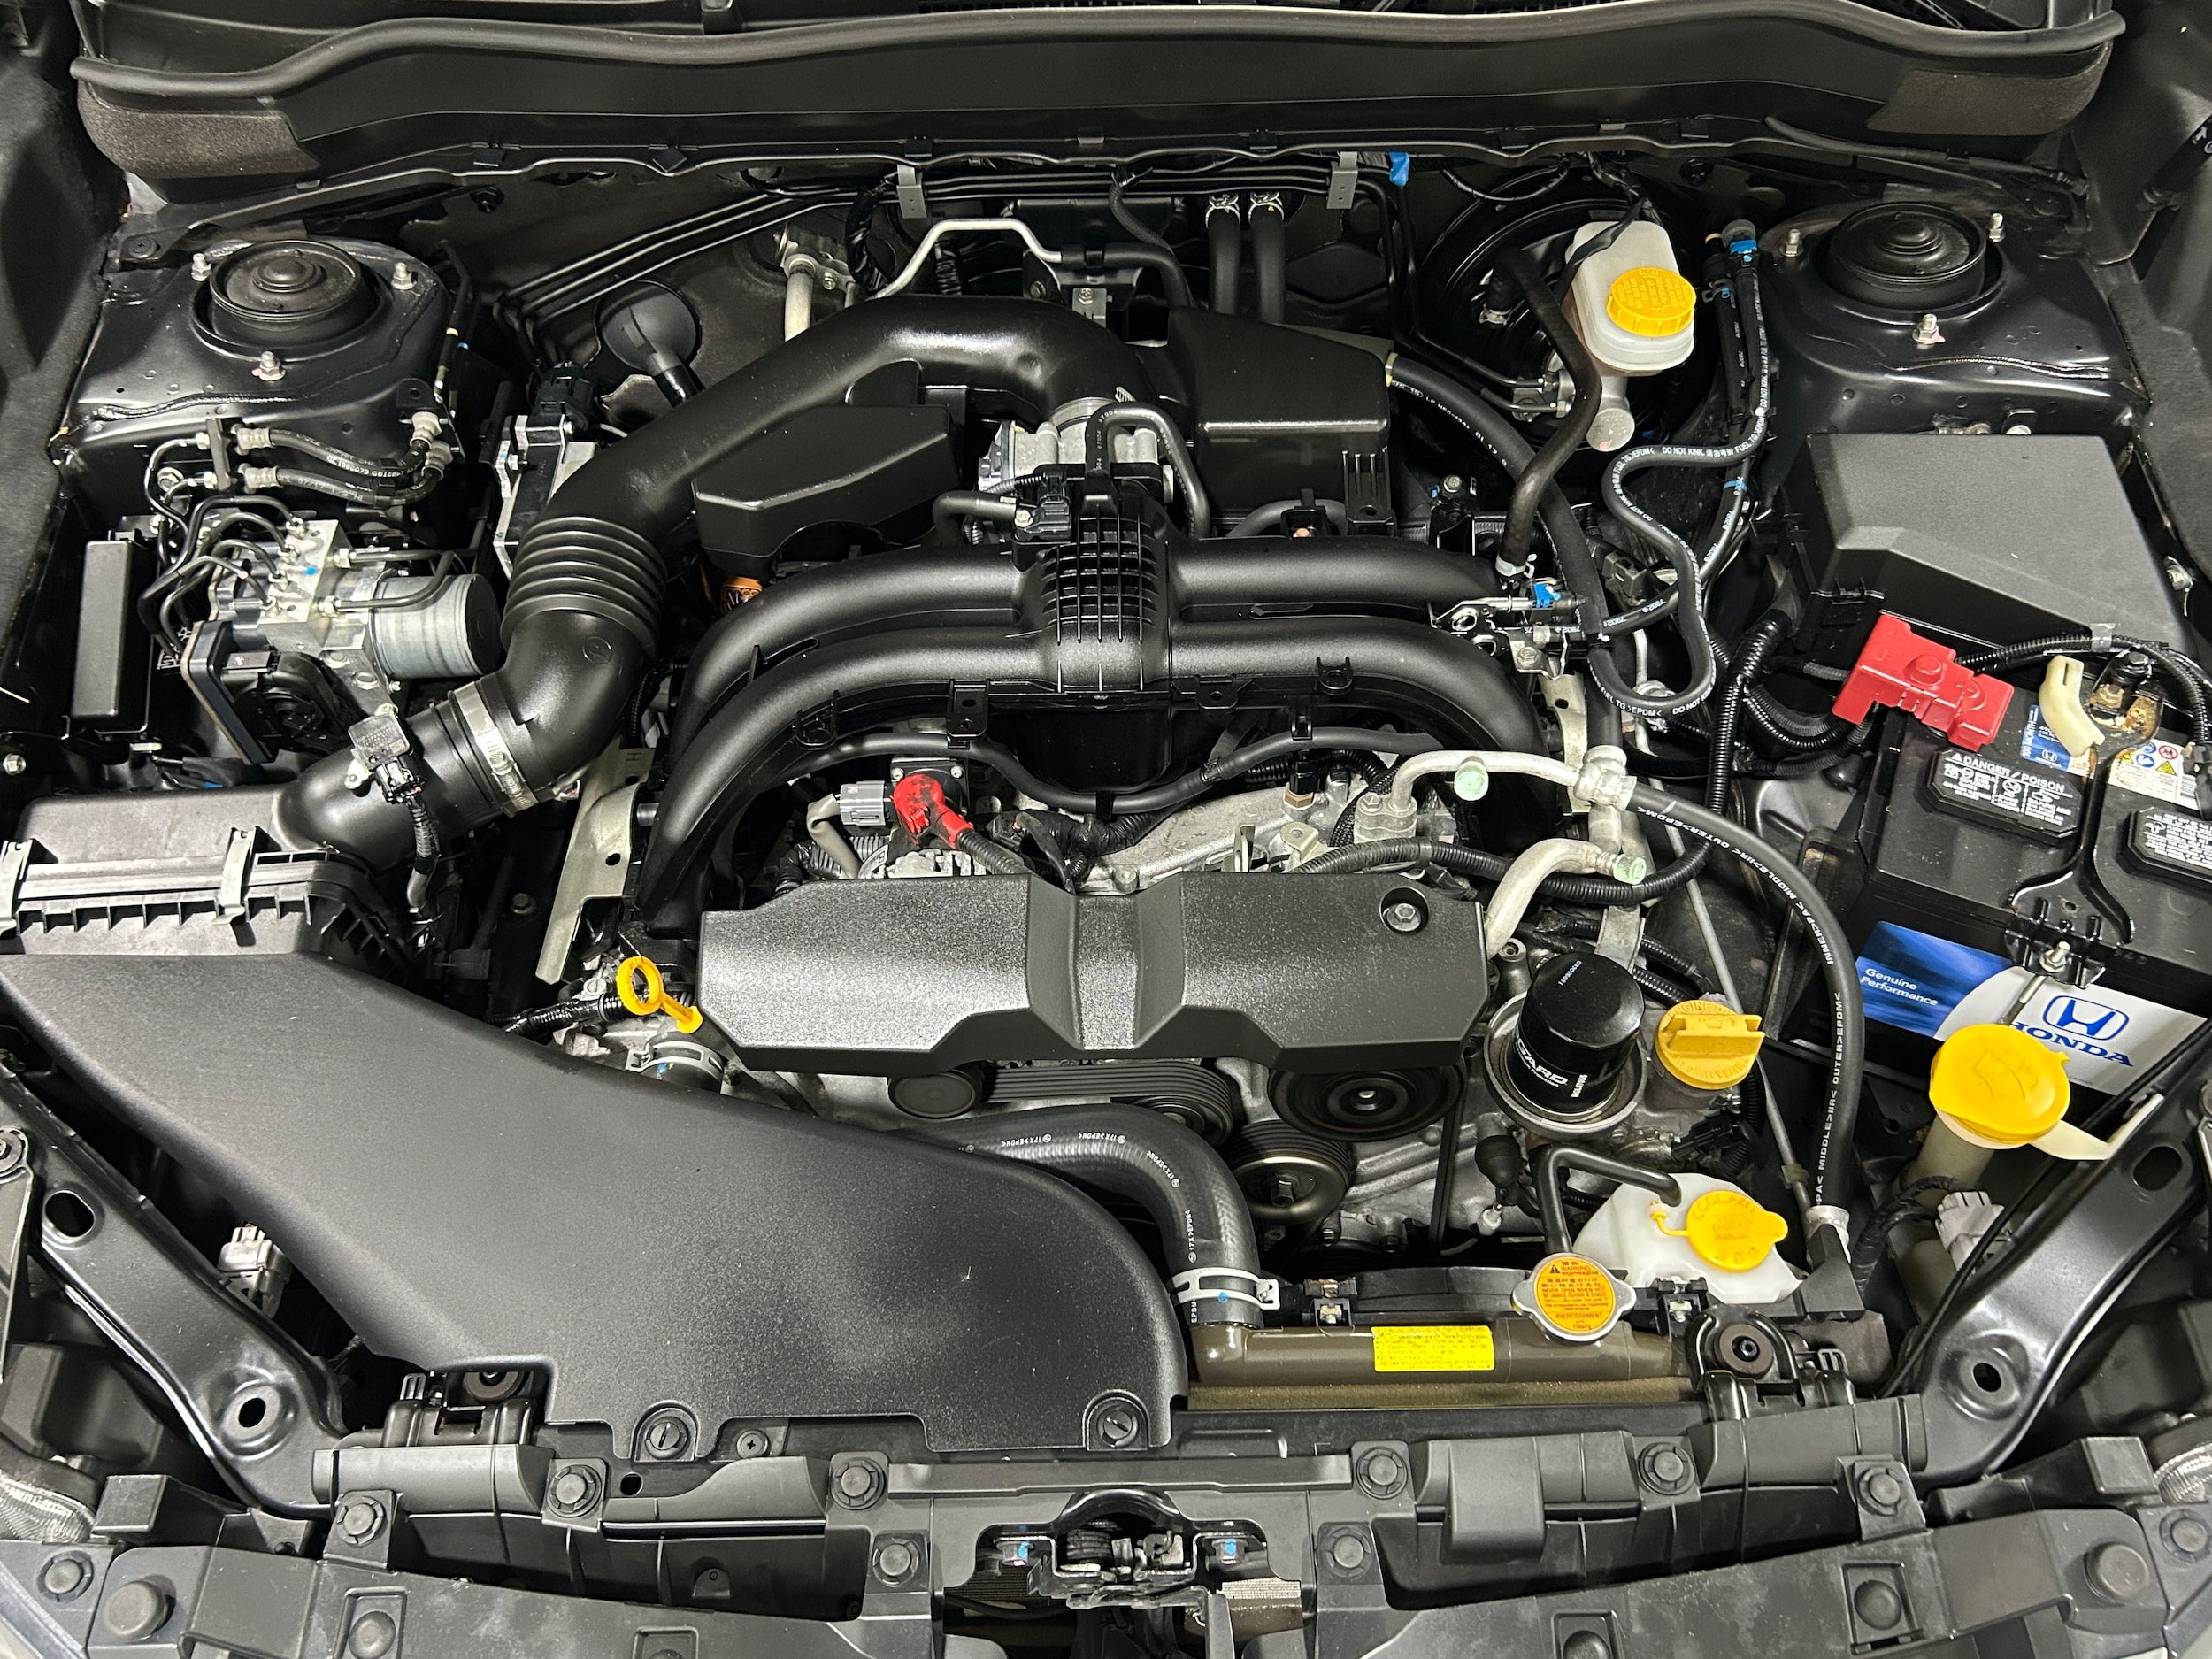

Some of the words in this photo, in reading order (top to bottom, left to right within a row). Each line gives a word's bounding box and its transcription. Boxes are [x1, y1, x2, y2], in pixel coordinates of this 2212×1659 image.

[1734, 441, 1752, 454] FUEL
[1613, 461, 1624, 474] FUEL
[1672, 705, 1685, 715] DO
[1686, 698, 1701, 710] NOT
[1962, 756, 2011, 777] DANGER
[2021, 773, 2066, 793] POISON
[1865, 968, 1918, 990] Genuine
[1860, 976, 1939, 1007] Performance
